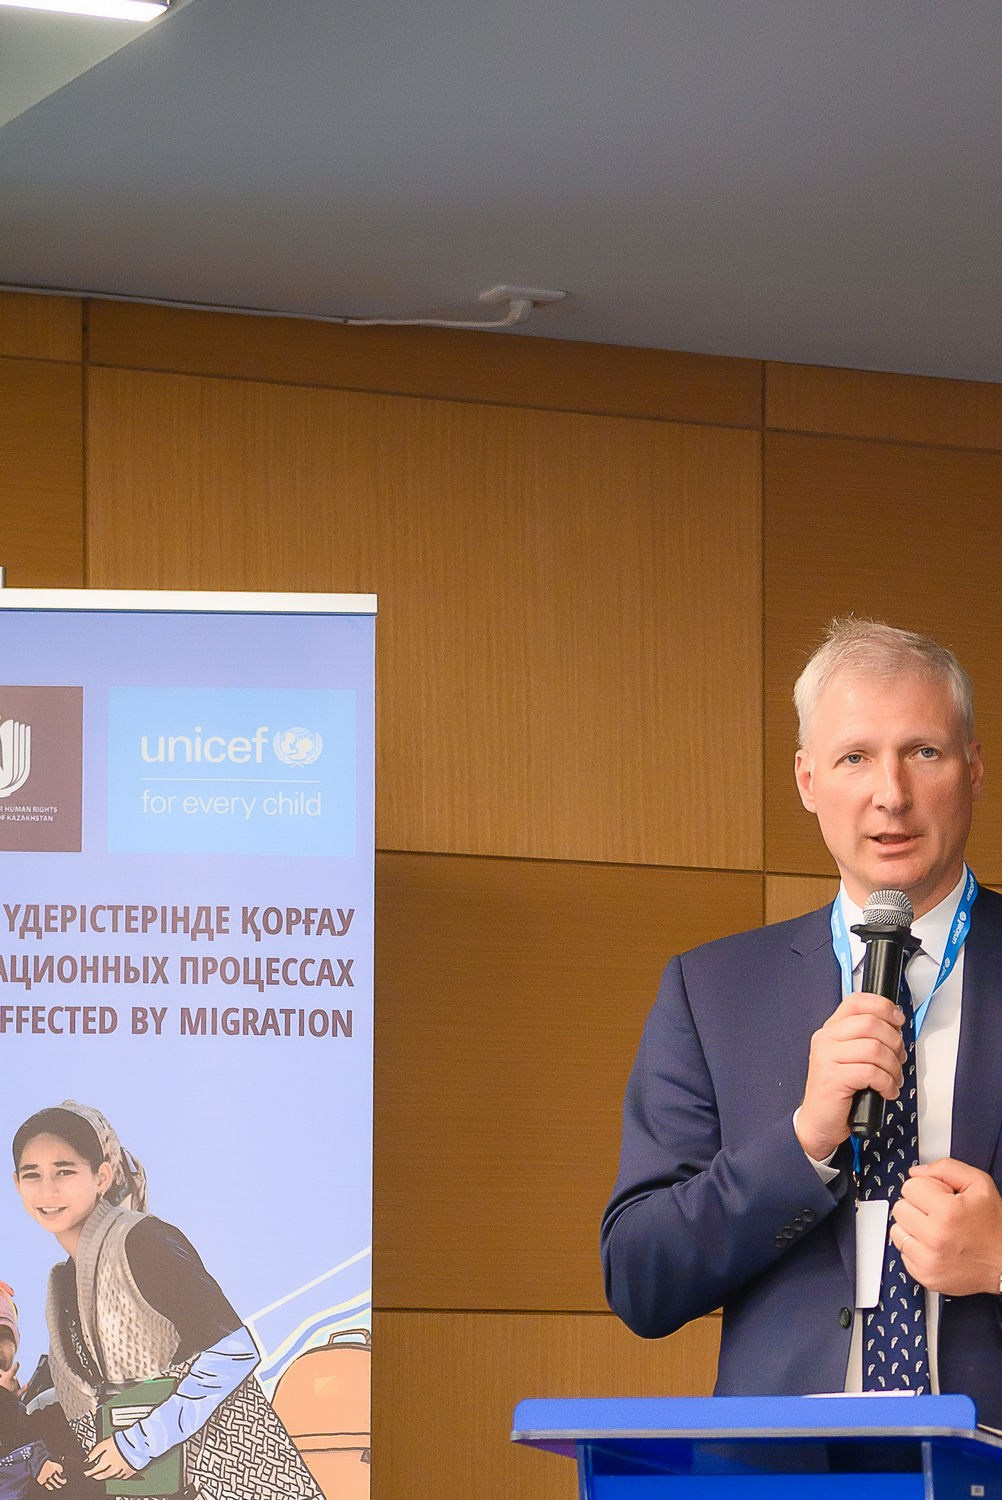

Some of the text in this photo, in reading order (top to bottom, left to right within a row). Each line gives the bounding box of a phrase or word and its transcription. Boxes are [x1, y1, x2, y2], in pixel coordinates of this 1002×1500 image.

[140, 726, 270, 763] unicef
[141, 789, 322, 820] for every child
[241, 906, 355, 942] ҚОРҒАУ
[951, 918, 966, 945] unicef
[180, 956, 355, 993] ПРОЦЕССАХ
[0, 1005, 353, 1038] FFECTED BY MIGRATION
